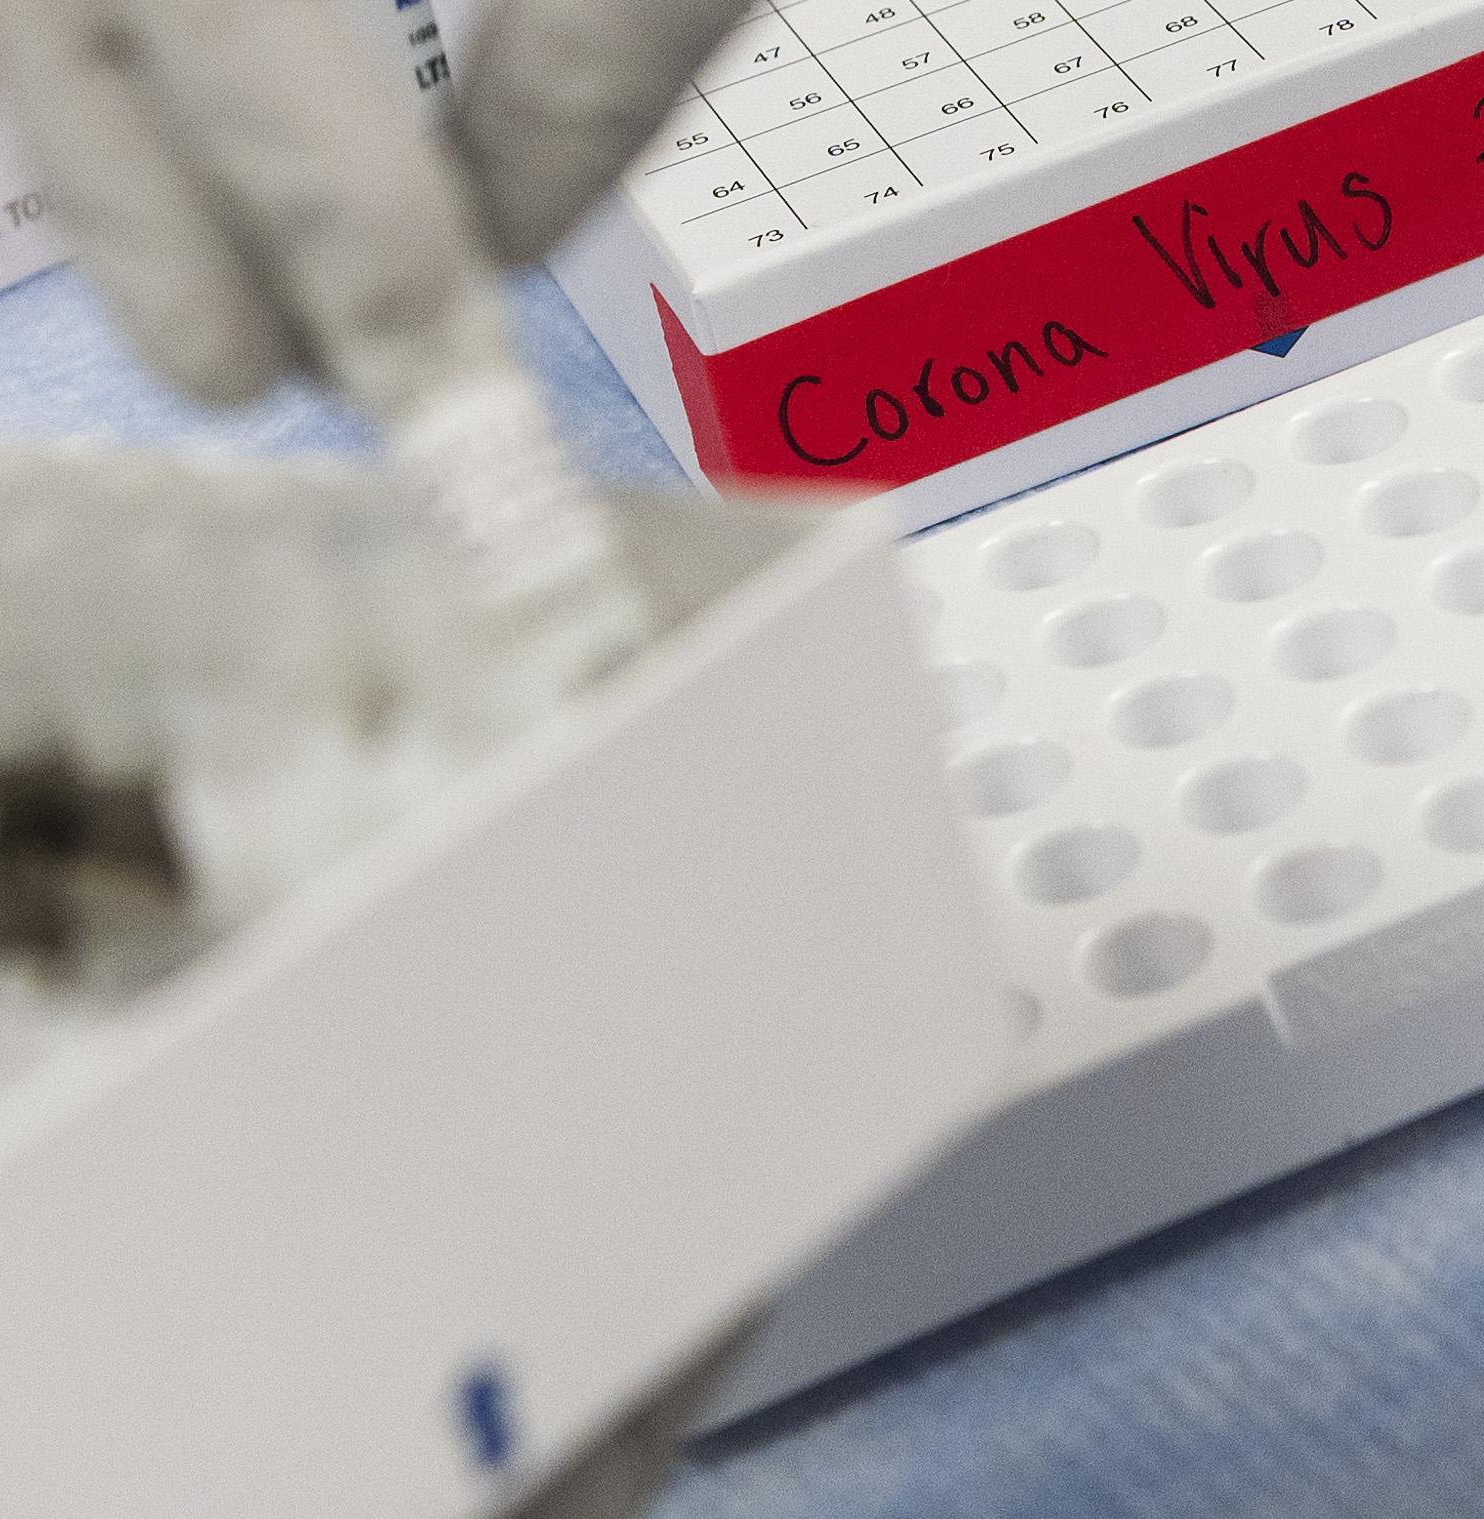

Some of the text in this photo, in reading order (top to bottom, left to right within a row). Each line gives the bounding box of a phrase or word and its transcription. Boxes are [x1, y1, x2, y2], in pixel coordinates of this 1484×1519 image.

[675, 132, 710, 151] 55
[788, 92, 823, 111] 56
[901, 51, 930, 70] 57
[1012, 11, 1046, 30] 58
[711, 180, 745, 199] 64
[826, 138, 861, 157] 65
[940, 97, 975, 115] 66
[1053, 55, 1083, 75] 67
[1164, 15, 1199, 33] 68
[753, 46, 781, 64] 47
[865, 7, 897, 24] 48
[748, 228, 785, 248] 73
[864, 185, 899, 205] 74
[980, 143, 1016, 162] 75
[1094, 101, 1130, 120] 76
[1206, 58, 1237, 78] 77
[1319, 18, 1355, 37] 78
[778, 319, 1109, 466] Corona
[1132, 170, 1393, 310] Virus
